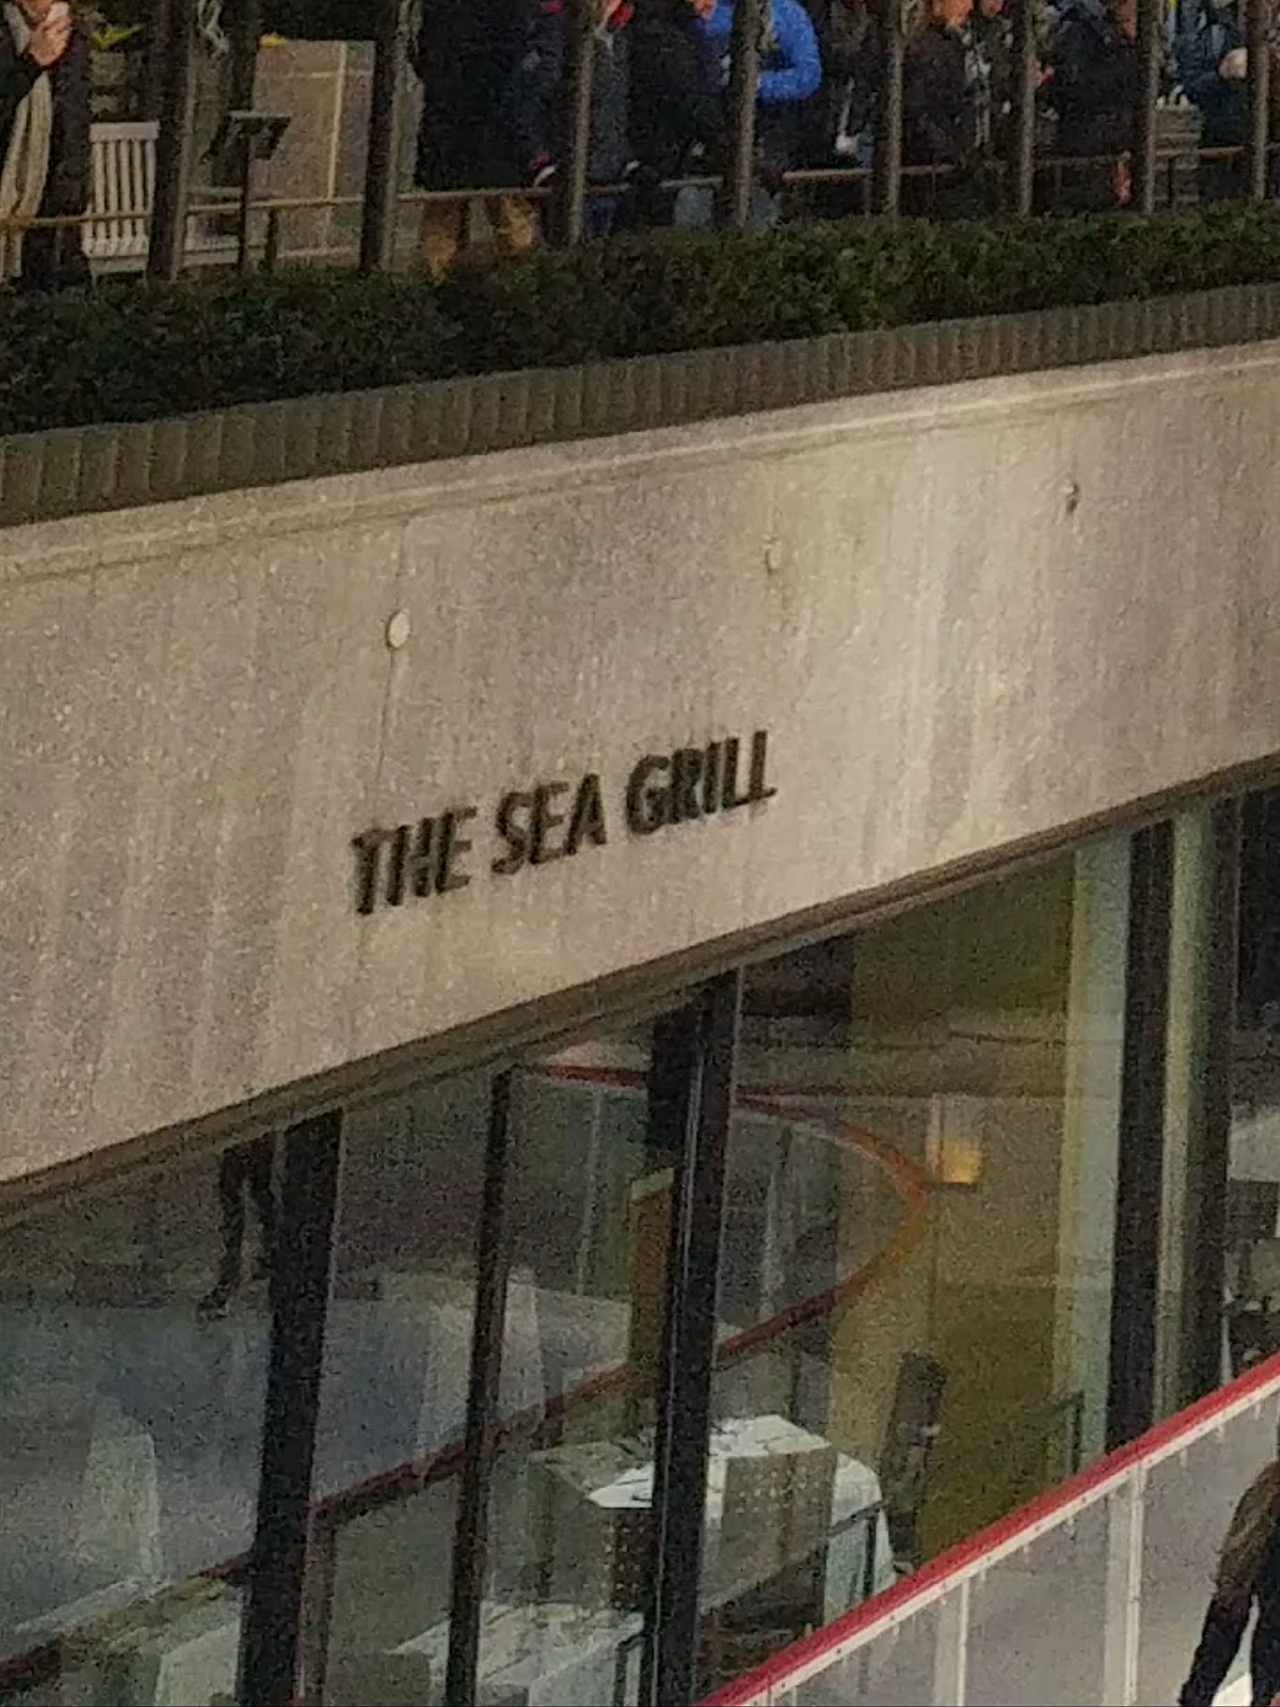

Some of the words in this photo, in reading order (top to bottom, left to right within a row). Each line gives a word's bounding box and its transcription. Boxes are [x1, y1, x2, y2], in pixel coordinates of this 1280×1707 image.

[350, 806, 478, 916] THE
[491, 773, 608, 876] SEA
[625, 729, 778, 836] GRILL
